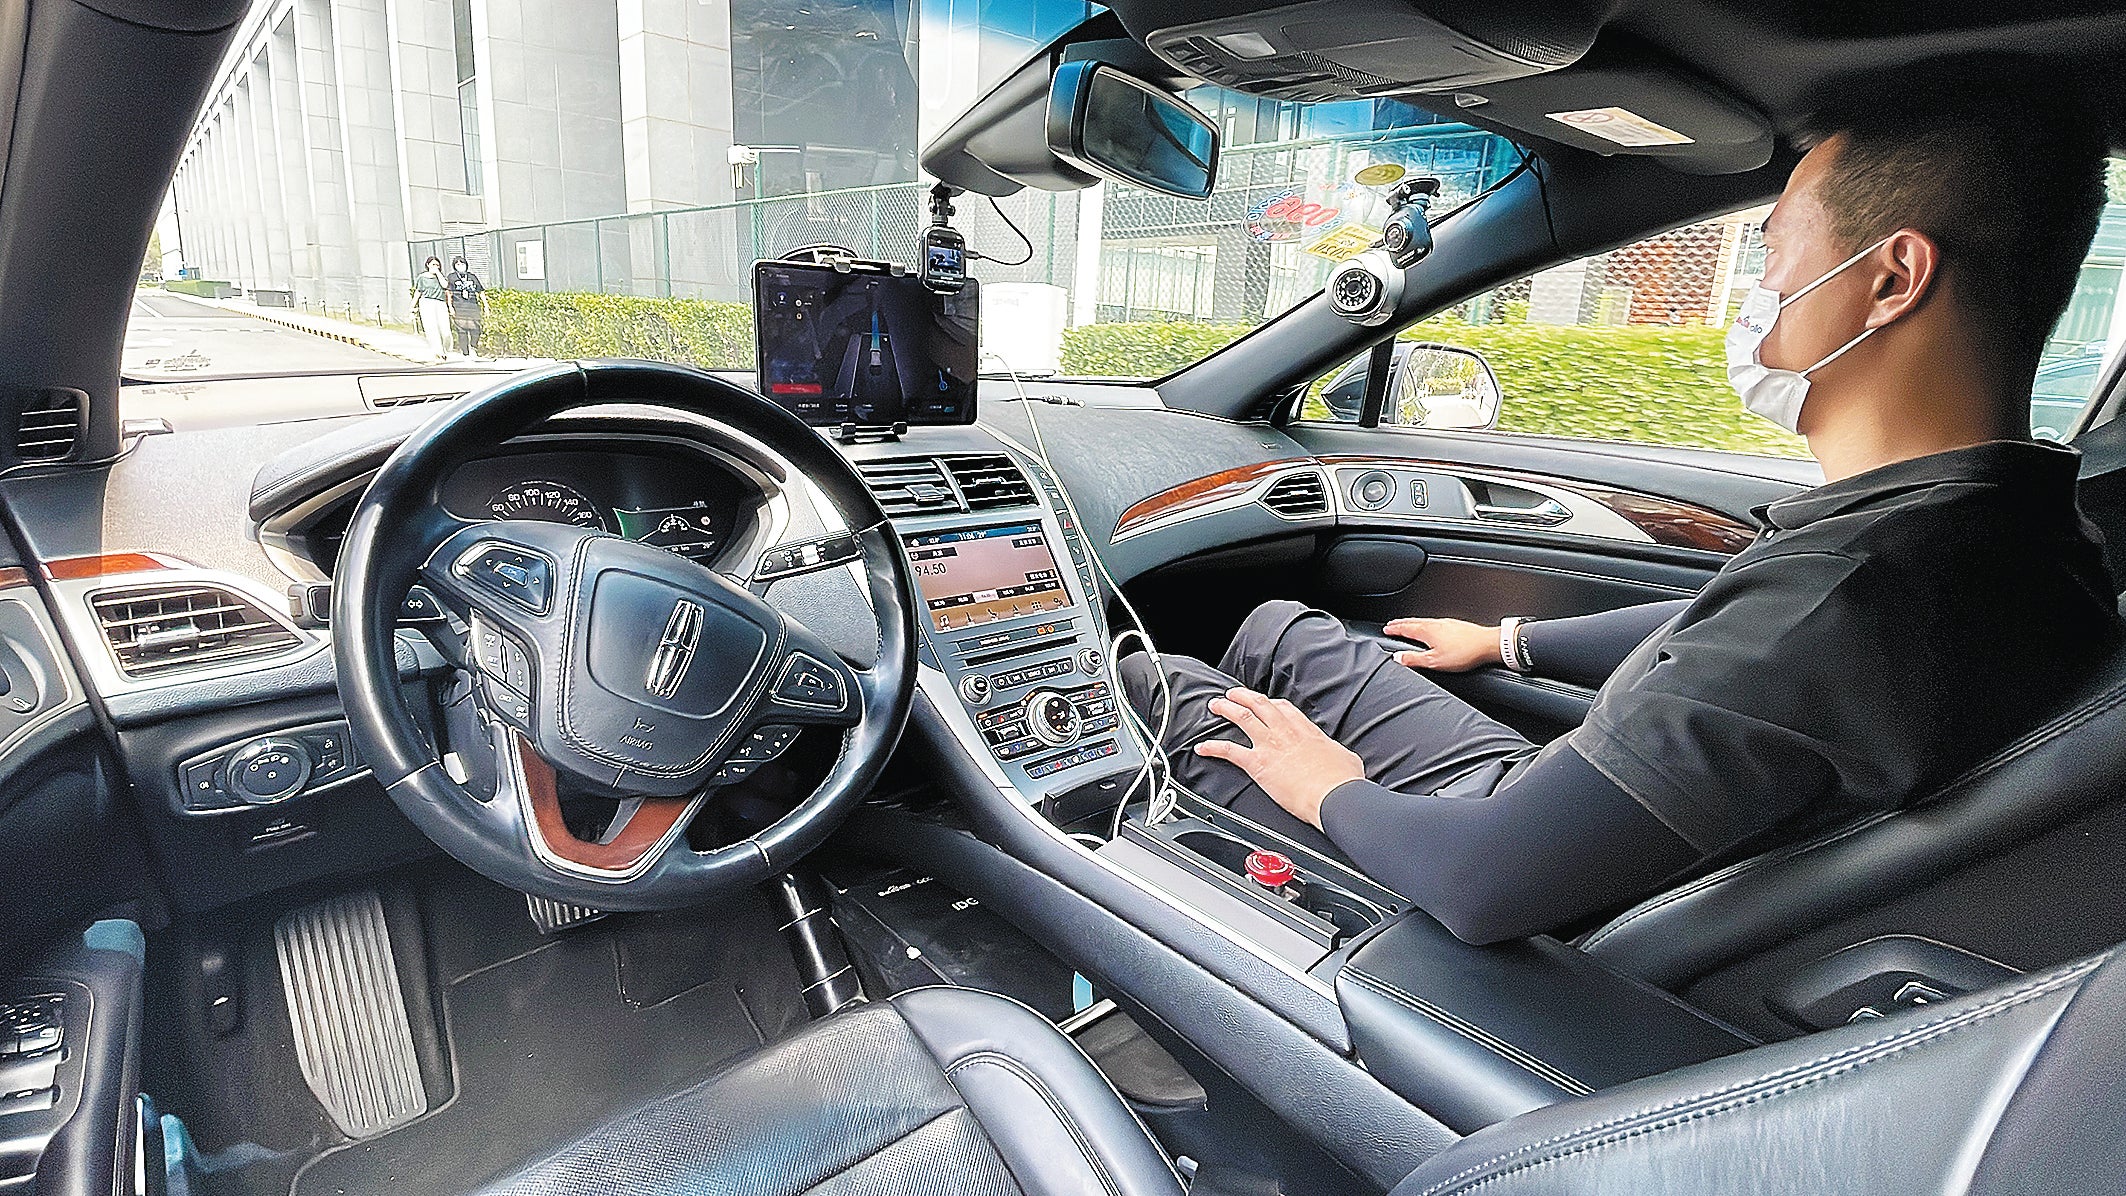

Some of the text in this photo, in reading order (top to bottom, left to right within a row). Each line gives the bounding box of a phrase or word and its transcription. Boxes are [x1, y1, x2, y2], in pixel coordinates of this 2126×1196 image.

[523, 488, 541, 497] 100
[544, 490, 561, 499] 120
[563, 498, 579, 506] 140
[491, 503, 505, 512] 60
[914, 563, 947, 577] 94.50
[619, 735, 654, 751] AIRBAG
